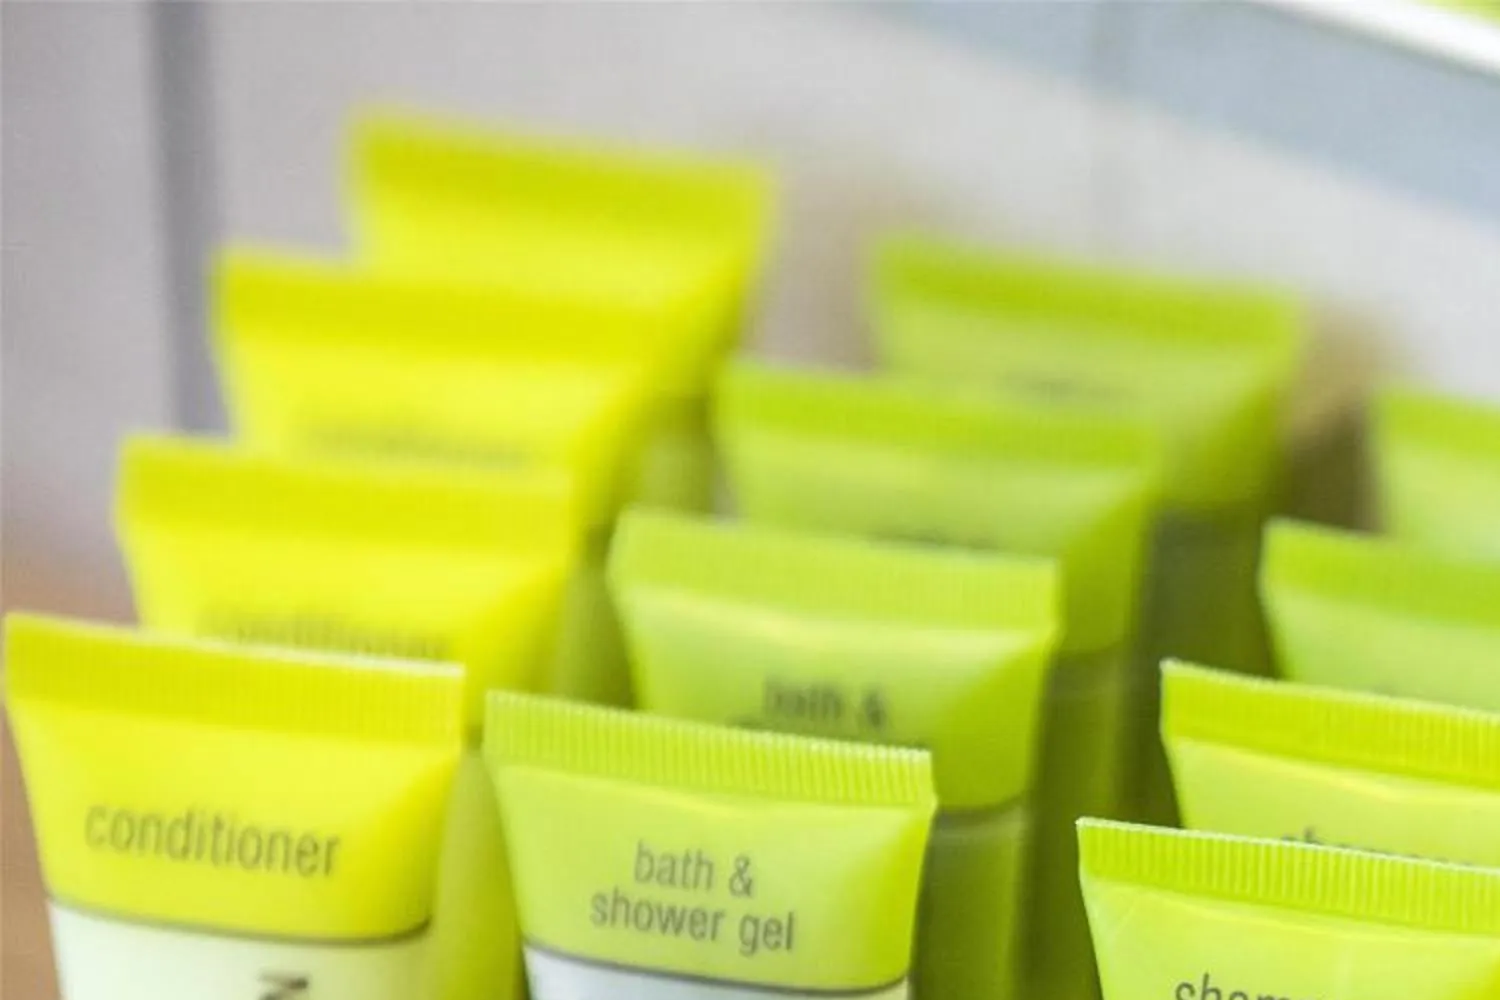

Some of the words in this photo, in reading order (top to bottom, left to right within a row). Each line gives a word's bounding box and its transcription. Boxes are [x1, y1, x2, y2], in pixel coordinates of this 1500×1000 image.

[85, 802, 341, 878] conditioner
[633, 838, 714, 891] bath
[728, 854, 755, 898] &
[589, 885, 724, 942] shower
[738, 909, 796, 958] gel
